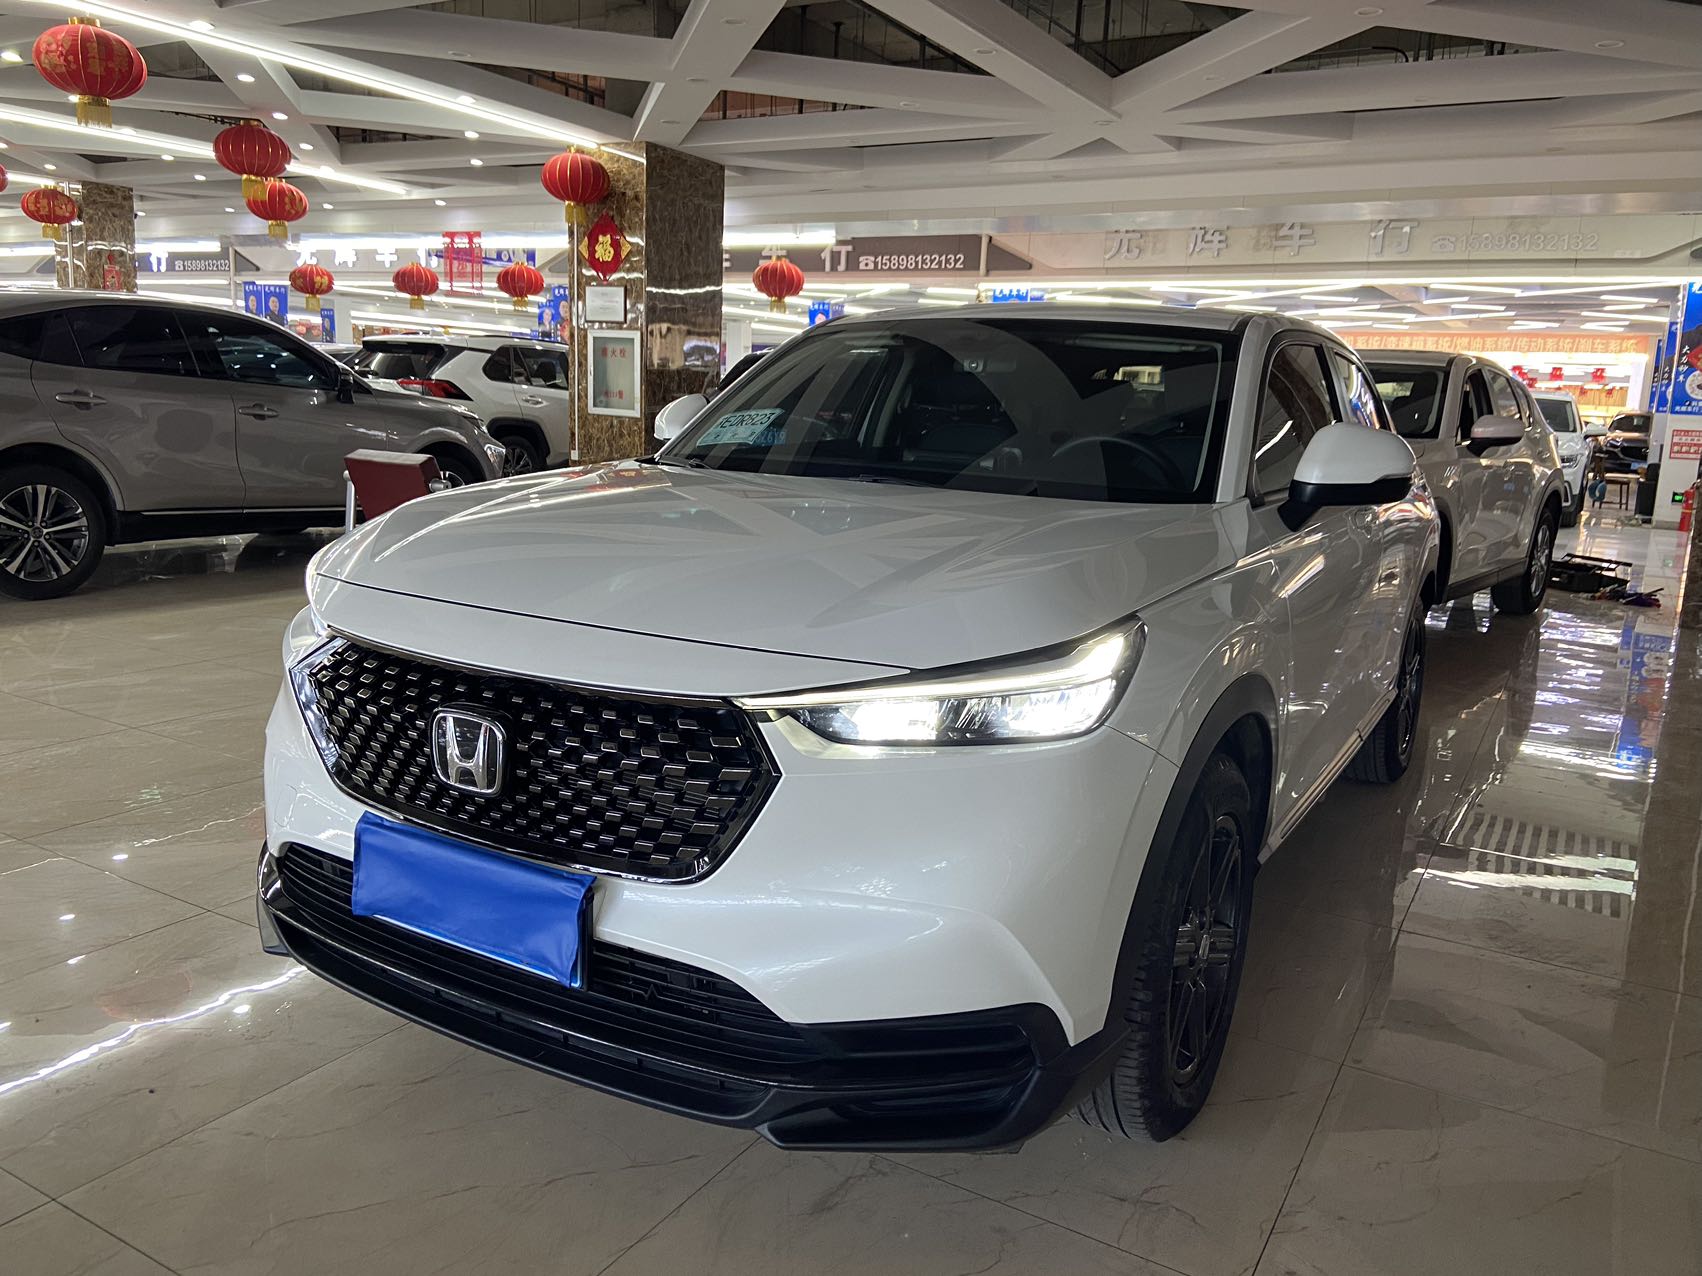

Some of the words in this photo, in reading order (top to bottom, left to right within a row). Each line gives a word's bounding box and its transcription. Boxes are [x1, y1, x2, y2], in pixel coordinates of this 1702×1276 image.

[595, 235, 614, 262] 福
[1459, 232, 1598, 252] 15898132132
[184, 260, 229, 270] 15898132132
[876, 254, 964, 270] 15898132132
